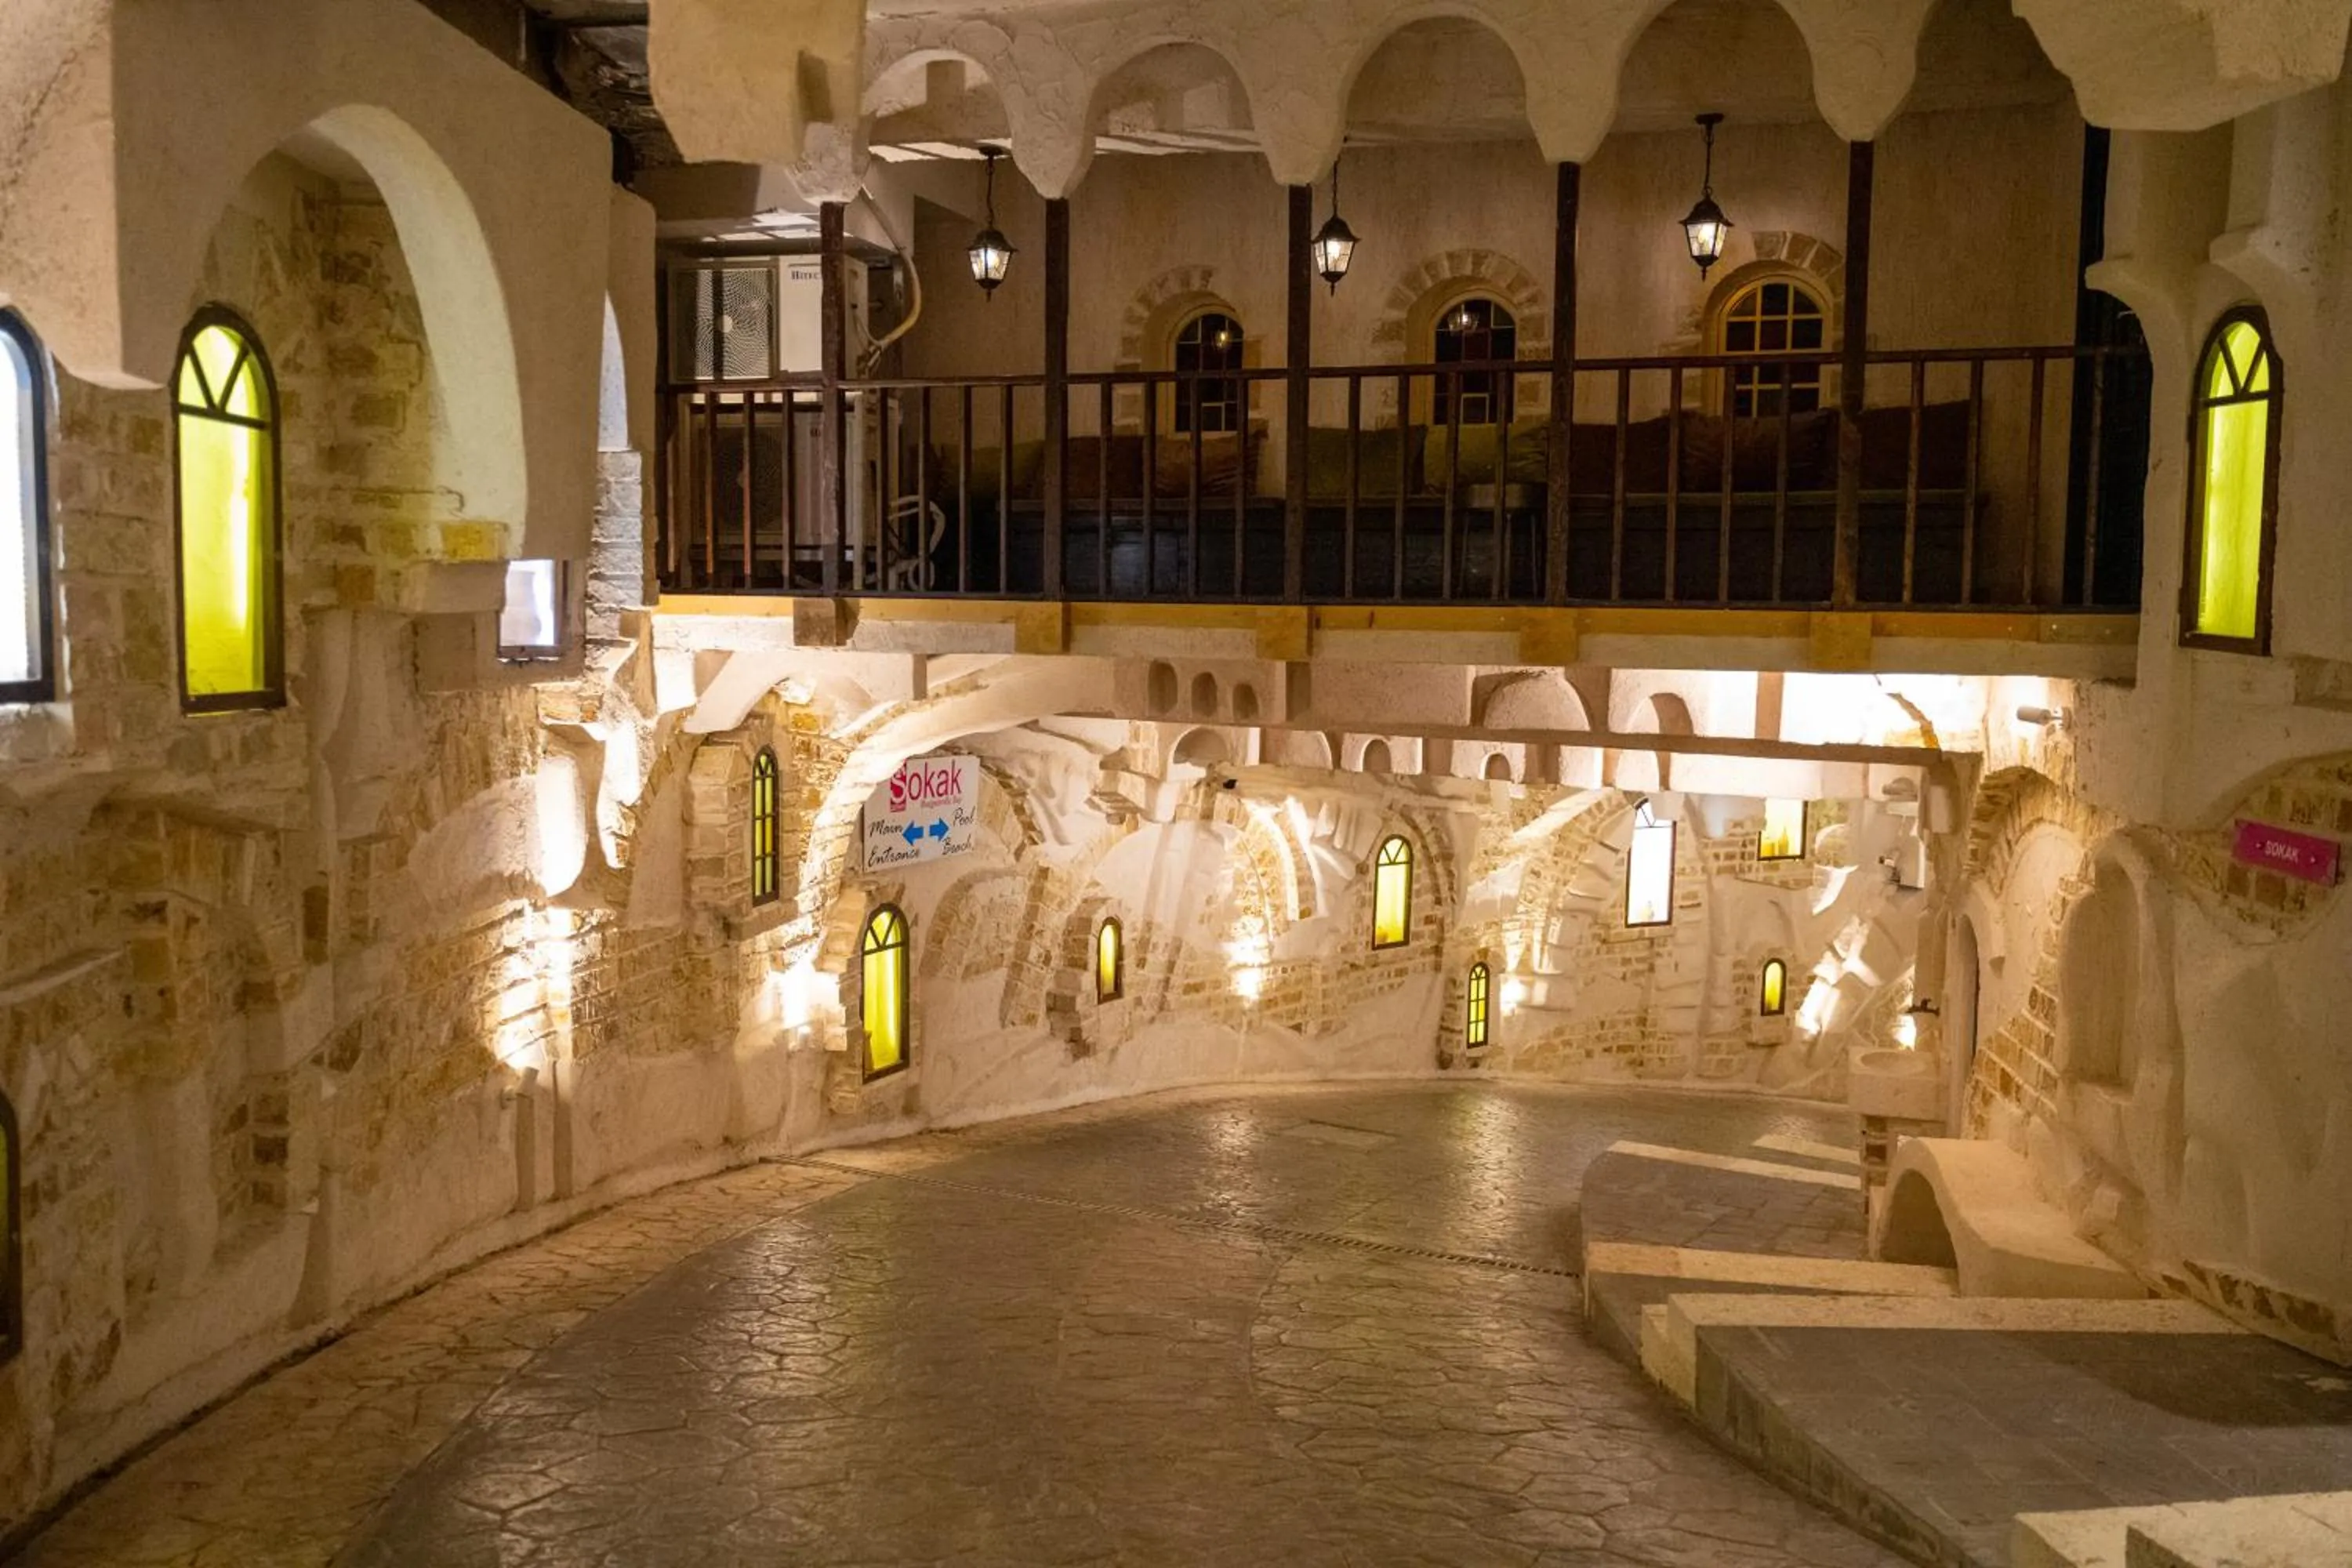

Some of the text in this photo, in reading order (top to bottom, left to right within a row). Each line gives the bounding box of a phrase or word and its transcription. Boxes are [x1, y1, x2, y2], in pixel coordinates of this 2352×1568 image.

[890, 760, 962, 803] Sokak
[953, 806, 976, 826] Pool
[869, 819, 902, 837] Main
[868, 845, 920, 867] Entrance
[2264, 840, 2299, 863] SOKAK
